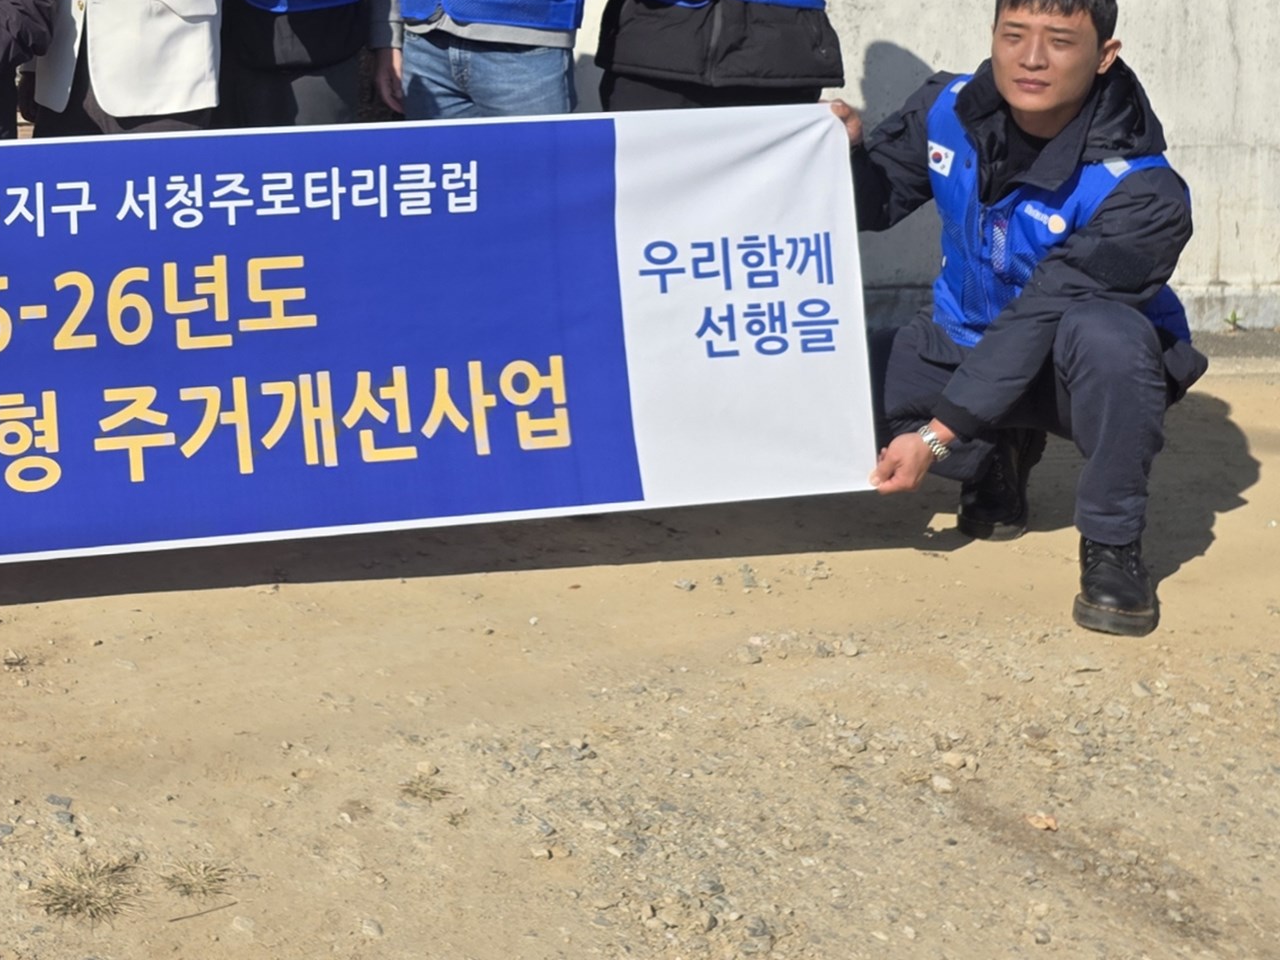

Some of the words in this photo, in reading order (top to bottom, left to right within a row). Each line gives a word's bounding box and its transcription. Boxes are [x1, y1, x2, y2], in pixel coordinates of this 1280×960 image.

[116, 160, 479, 231] 서청주로타리클럽
[638, 231, 835, 295] 우리함께
[694, 297, 840, 359] 선행을
[93, 354, 572, 483] 주거개선사업
